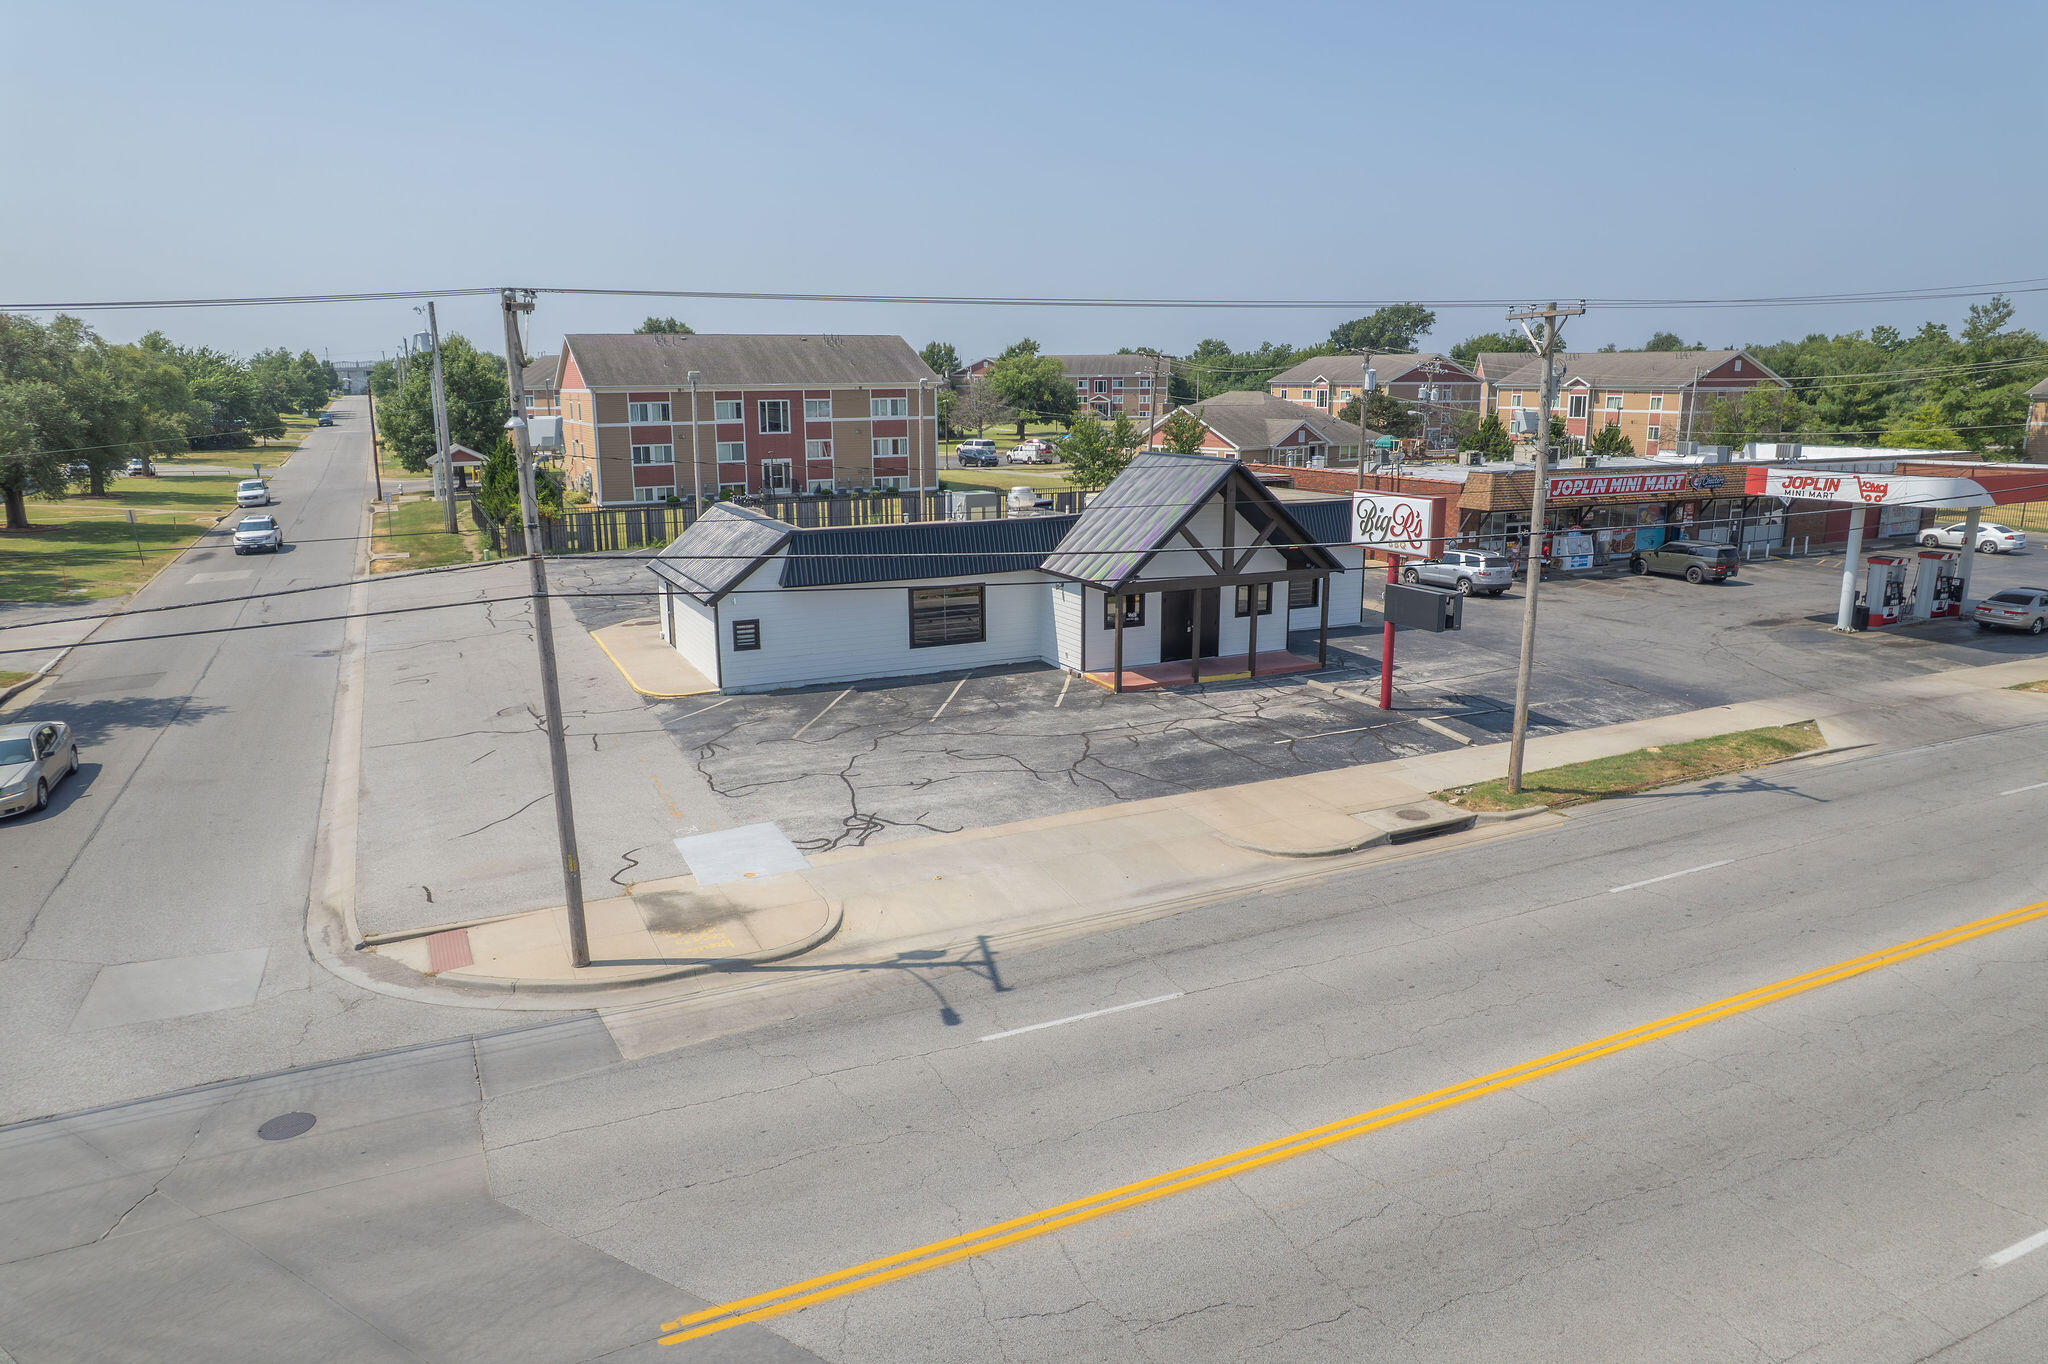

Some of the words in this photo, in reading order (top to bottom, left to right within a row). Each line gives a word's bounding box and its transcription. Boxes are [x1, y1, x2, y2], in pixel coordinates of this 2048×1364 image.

[1552, 479, 1608, 496] JOPLIN
[1609, 477, 1642, 493] MINI
[1643, 475, 1685, 491] MART
[1782, 476, 1840, 492] JOPLIN
[1784, 489, 1805, 497] MINI
[1808, 491, 1835, 499] MART
[1357, 498, 1392, 542] Big
[1389, 503, 1423, 549] R's
